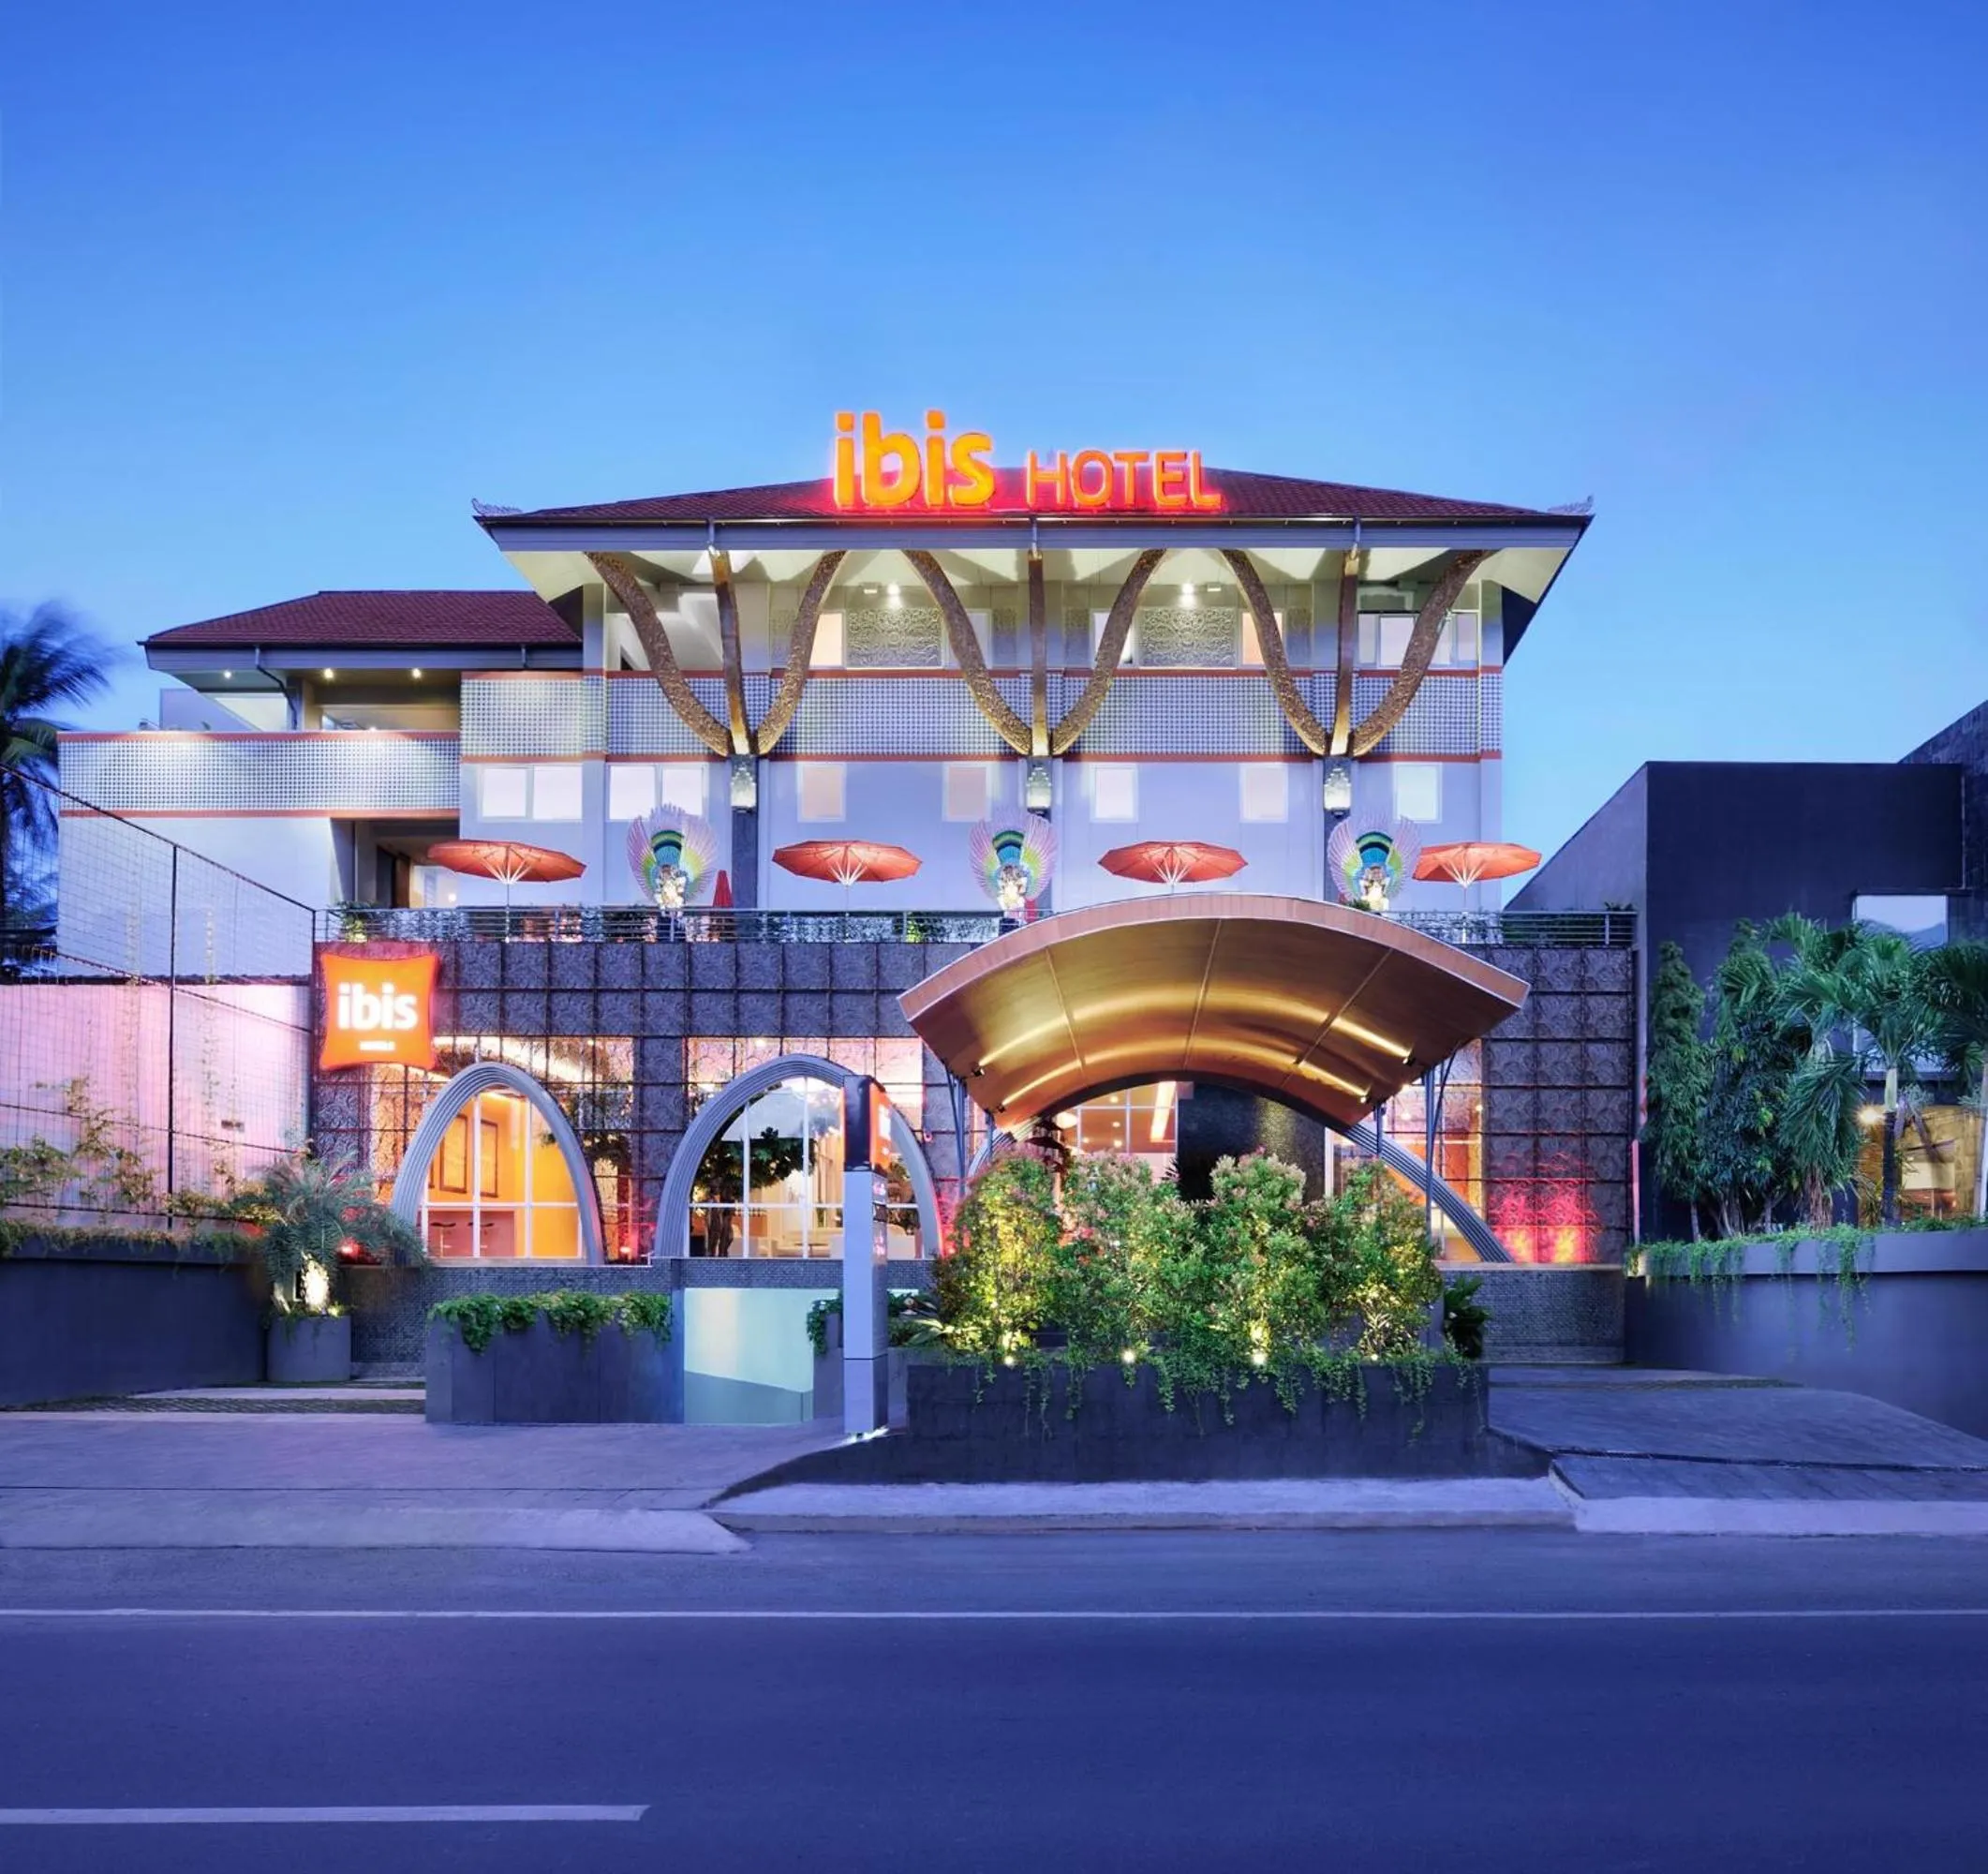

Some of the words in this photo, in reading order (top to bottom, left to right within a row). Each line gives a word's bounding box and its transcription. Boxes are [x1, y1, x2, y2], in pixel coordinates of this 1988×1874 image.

[836, 409, 996, 507] ibis
[1028, 450, 1222, 508] HOTEL
[338, 981, 417, 1030] ibis
